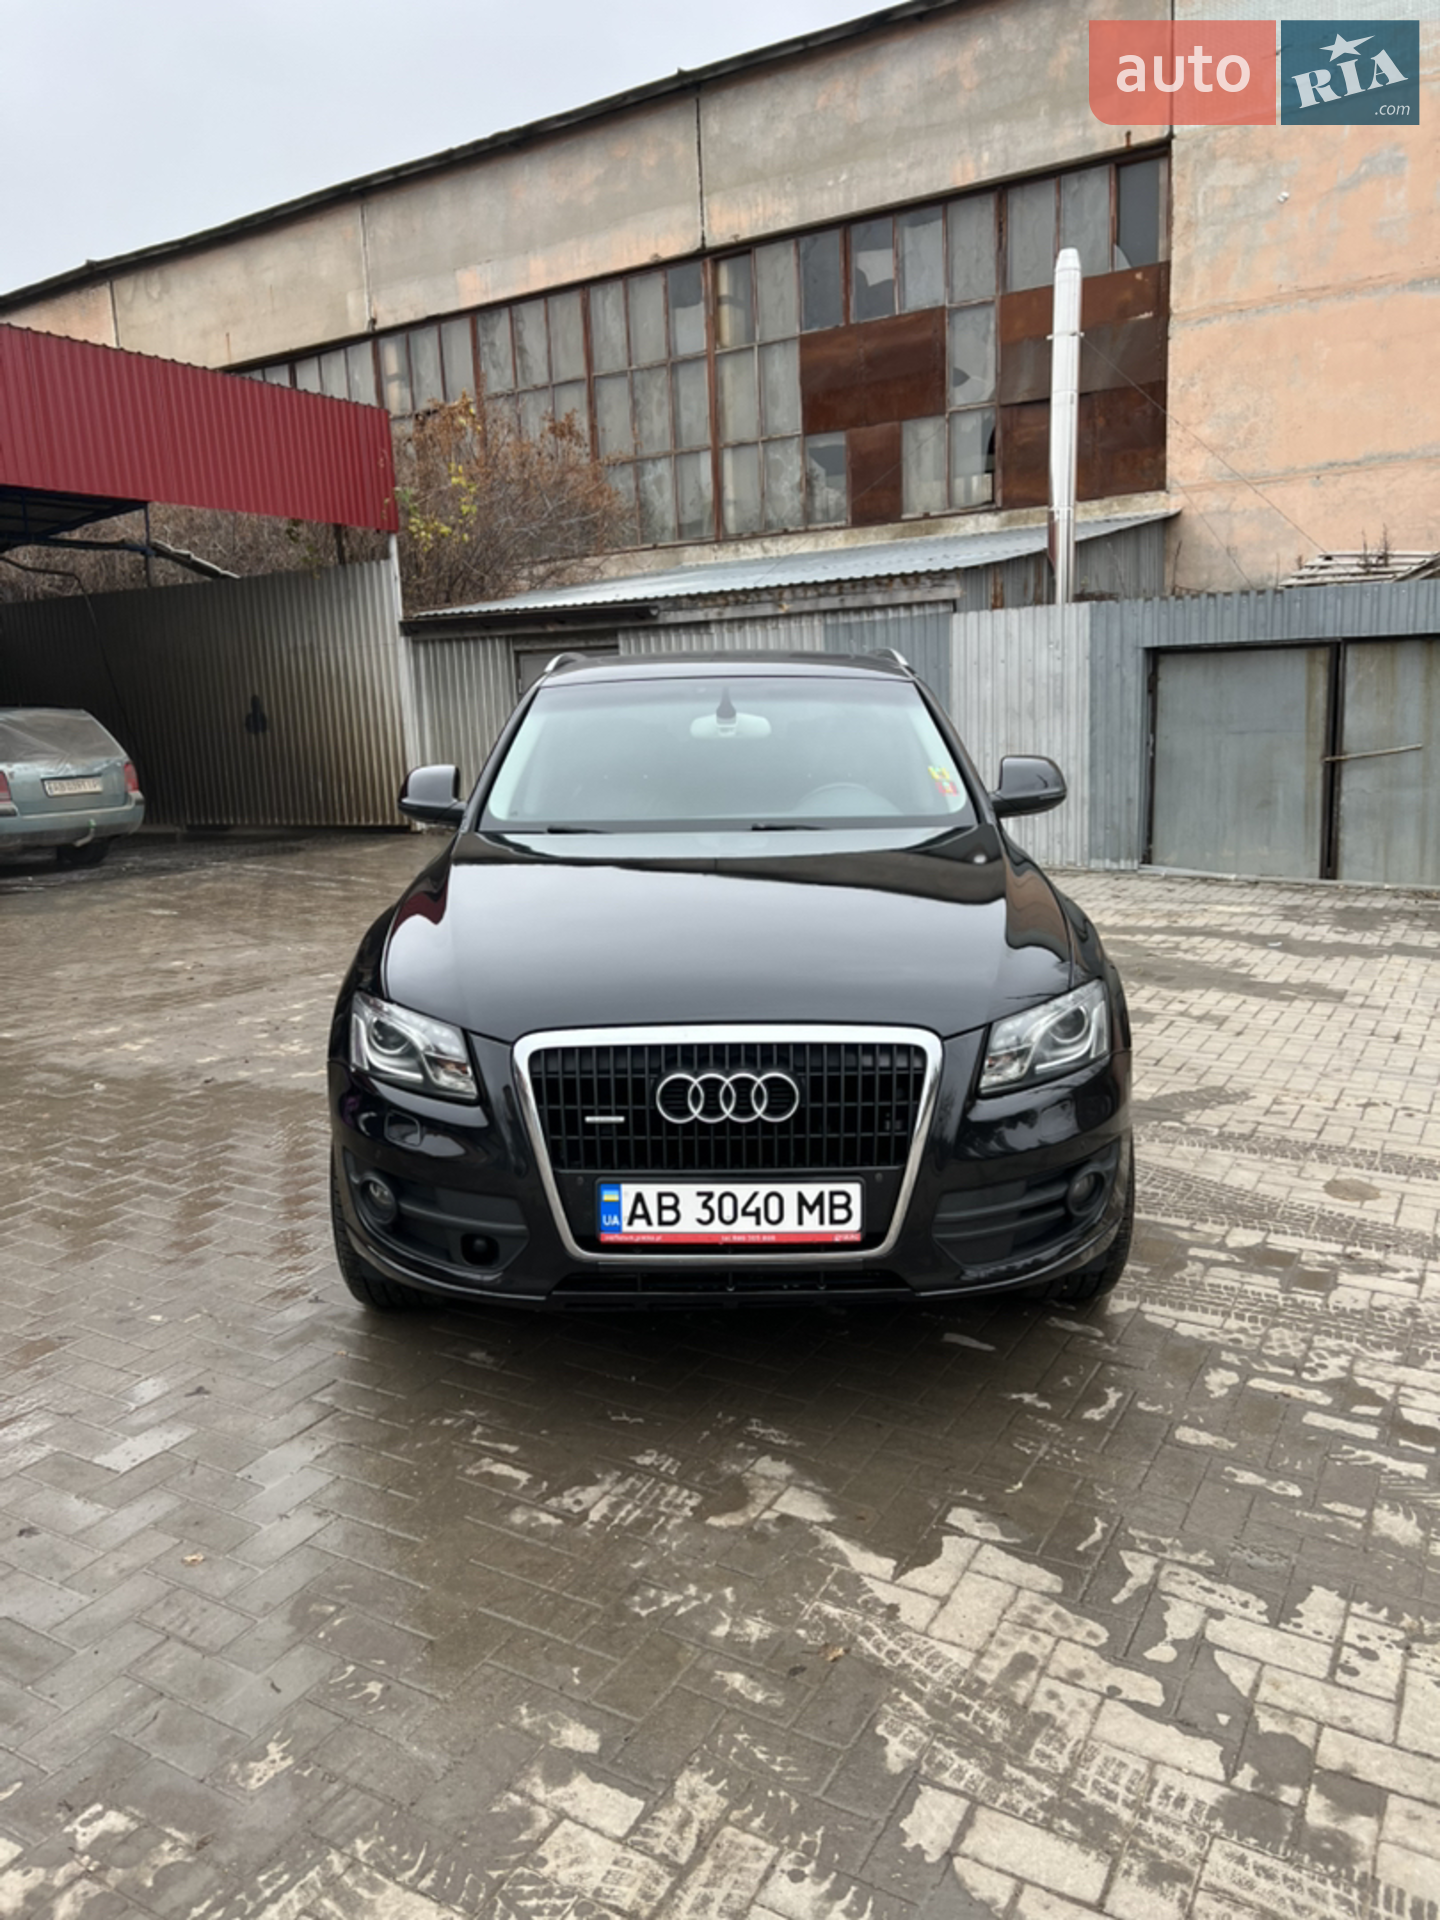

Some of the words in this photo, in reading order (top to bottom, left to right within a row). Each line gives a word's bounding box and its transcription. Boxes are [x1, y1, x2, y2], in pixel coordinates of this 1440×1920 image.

[602, 1215, 620, 1226] UA
[627, 1191, 681, 1227] AB
[696, 1190, 784, 1226] 3040
[797, 1190, 853, 1226] MB
